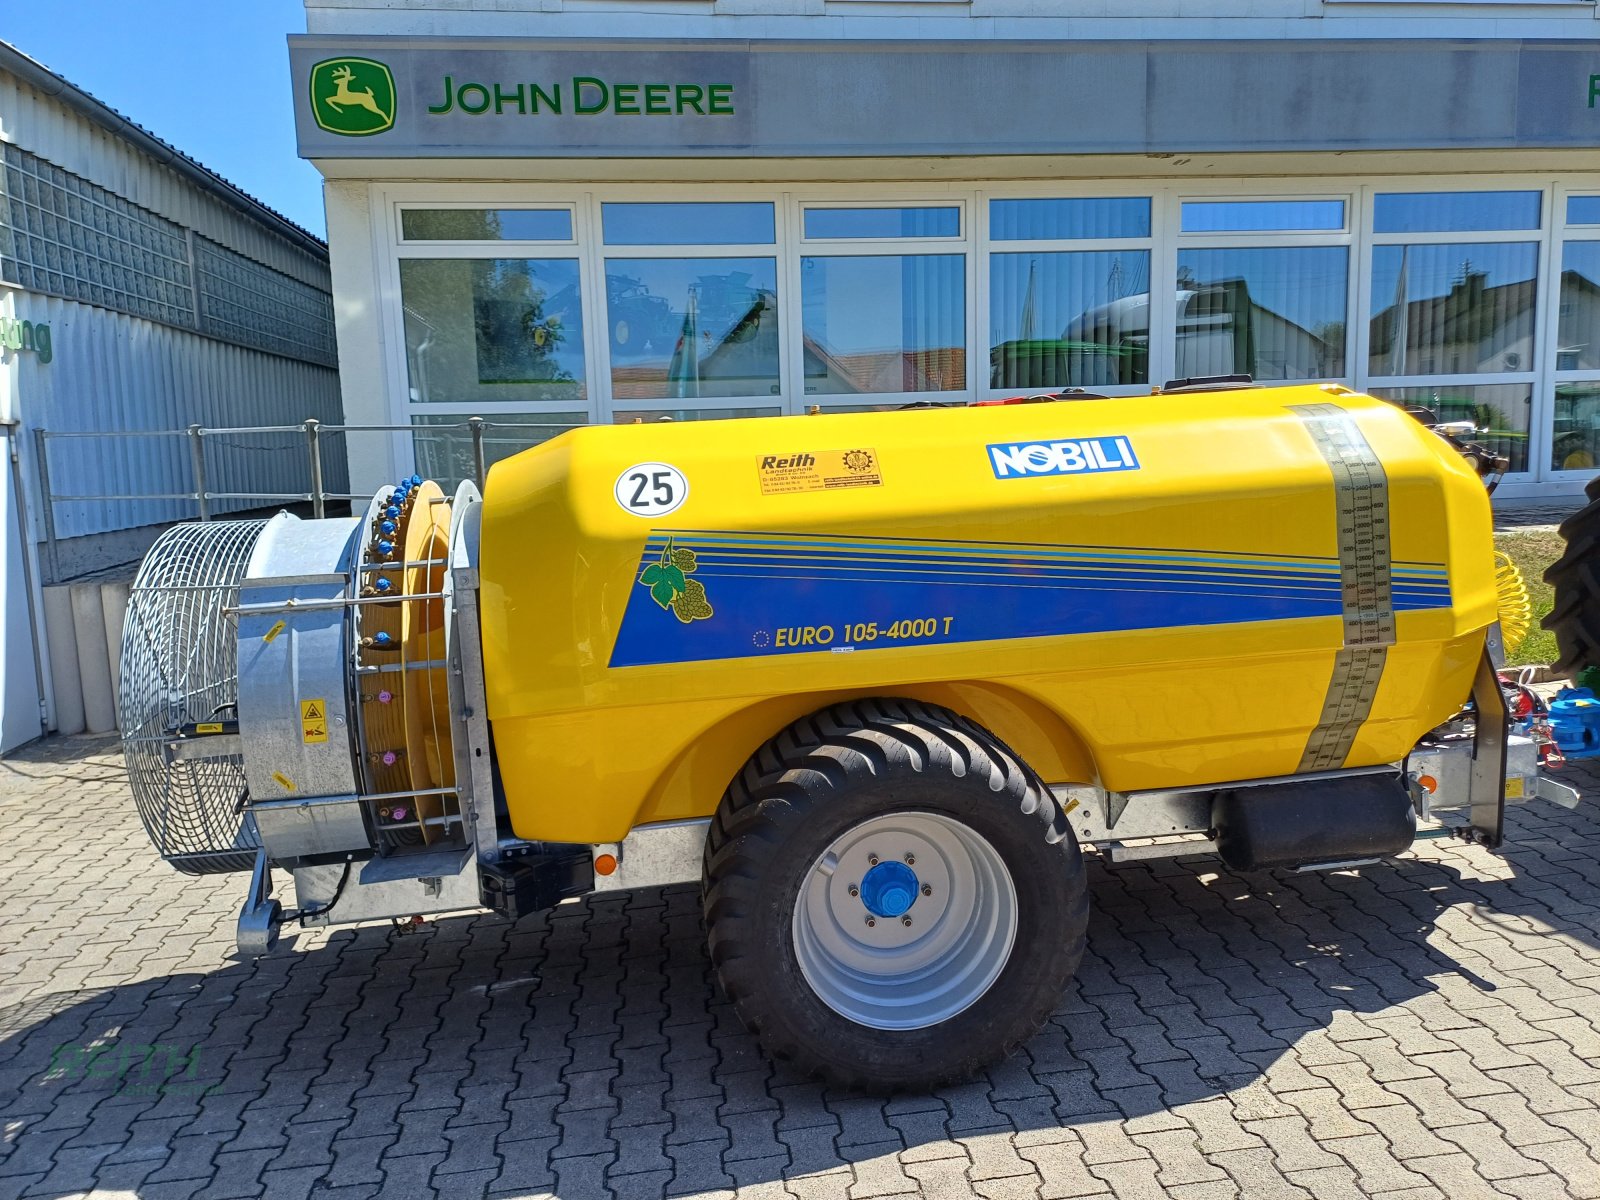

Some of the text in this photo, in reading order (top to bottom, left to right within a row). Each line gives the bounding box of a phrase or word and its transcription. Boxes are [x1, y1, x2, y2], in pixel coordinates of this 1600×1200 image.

[428, 76, 735, 116] JOHN DEERE
[761, 453, 816, 469] Reith
[990, 438, 1135, 476] NOBILI
[628, 471, 674, 508] 25
[775, 616, 954, 647] EURO 105-4000 T
